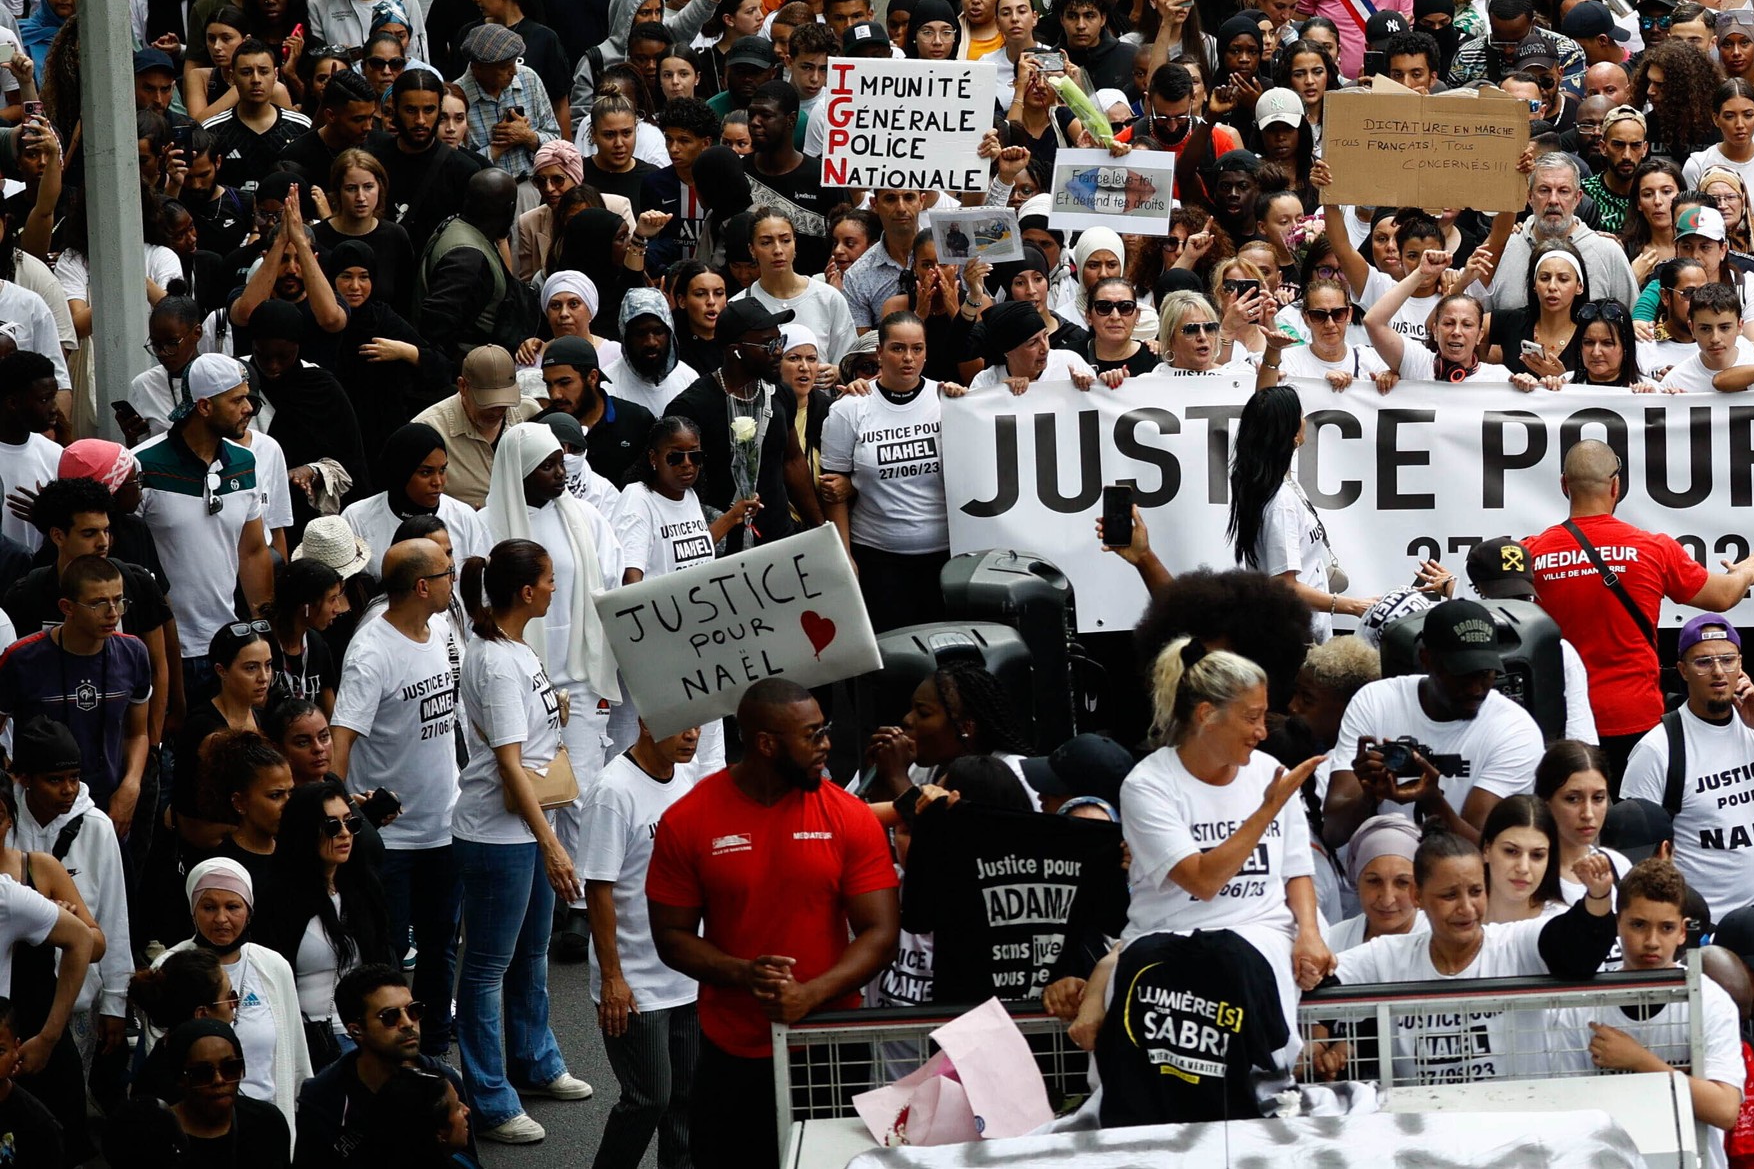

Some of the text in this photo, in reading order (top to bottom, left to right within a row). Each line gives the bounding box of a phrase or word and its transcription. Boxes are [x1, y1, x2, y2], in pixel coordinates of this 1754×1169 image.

[827, 96, 976, 132] GÉNÉRALE
[1363, 118, 1514, 135] DICTATURE EN MARCHE
[1072, 169, 1109, 185] France
[1056, 192, 1069, 205] Et
[1114, 196, 1130, 208] tes
[1134, 195, 1164, 210] droits
[861, 421, 942, 444] JUSTICE POU
[879, 440, 935, 463] NAHEL
[960, 407, 1436, 518] JUSTCE
[879, 462, 939, 481] 27/06/23
[660, 519, 708, 539] USTICE POU
[675, 538, 711, 562] NAHEL
[1534, 546, 1638, 571] MEDIAEUR
[1543, 565, 1627, 581] VILLE DE NANRRE
[690, 616, 775, 659] POUR
[681, 648, 785, 700] NAËL
[402, 673, 443, 701] JUSTICE
[422, 692, 454, 721] NAHE
[1191, 819, 1235, 842] STICE
[976, 853, 1082, 879] Justice pour
[992, 940, 1030, 961] sans
[882, 969, 934, 1002] NAHE
[1398, 1013, 1461, 1030] USTICE
